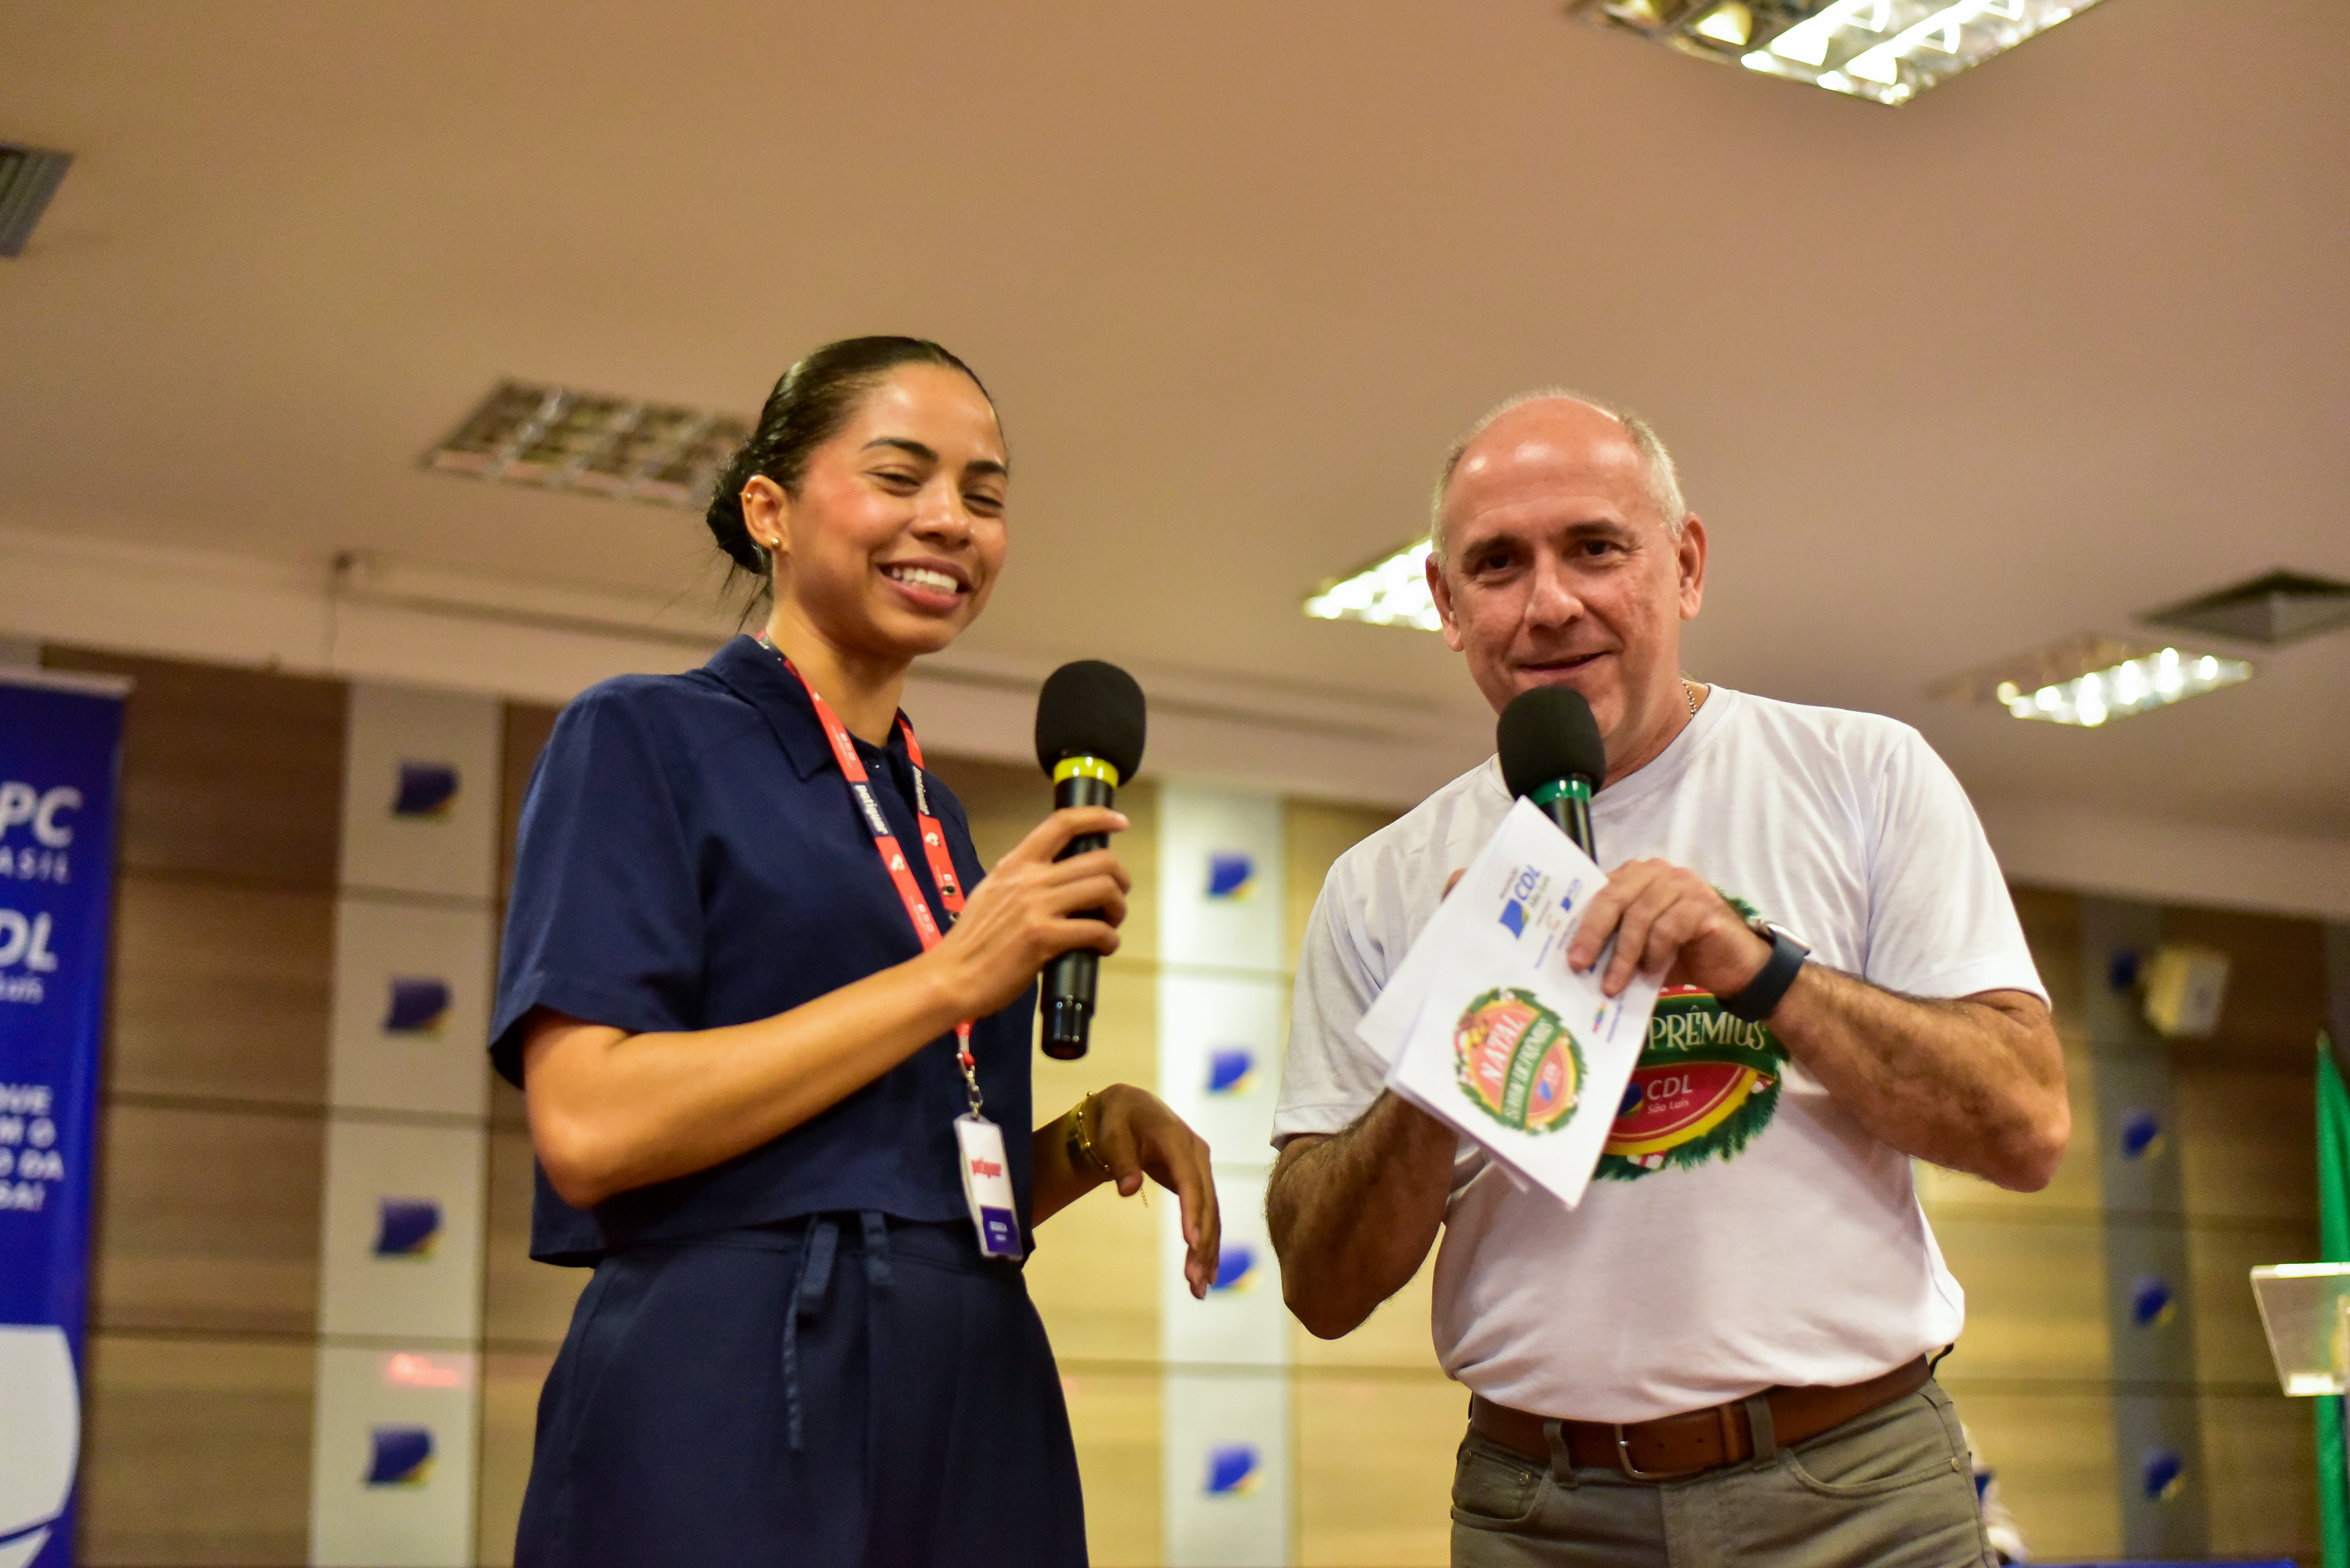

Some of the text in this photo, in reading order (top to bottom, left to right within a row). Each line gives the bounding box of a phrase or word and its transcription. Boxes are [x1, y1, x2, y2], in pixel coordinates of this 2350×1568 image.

[0, 781, 83, 848] PC
[1480, 1014, 1526, 1086] NATAL
[1648, 1005, 1765, 1051] PRÊMIOS
[1647, 1074, 1693, 1101] CDL
[1647, 1101, 1666, 1114] São
